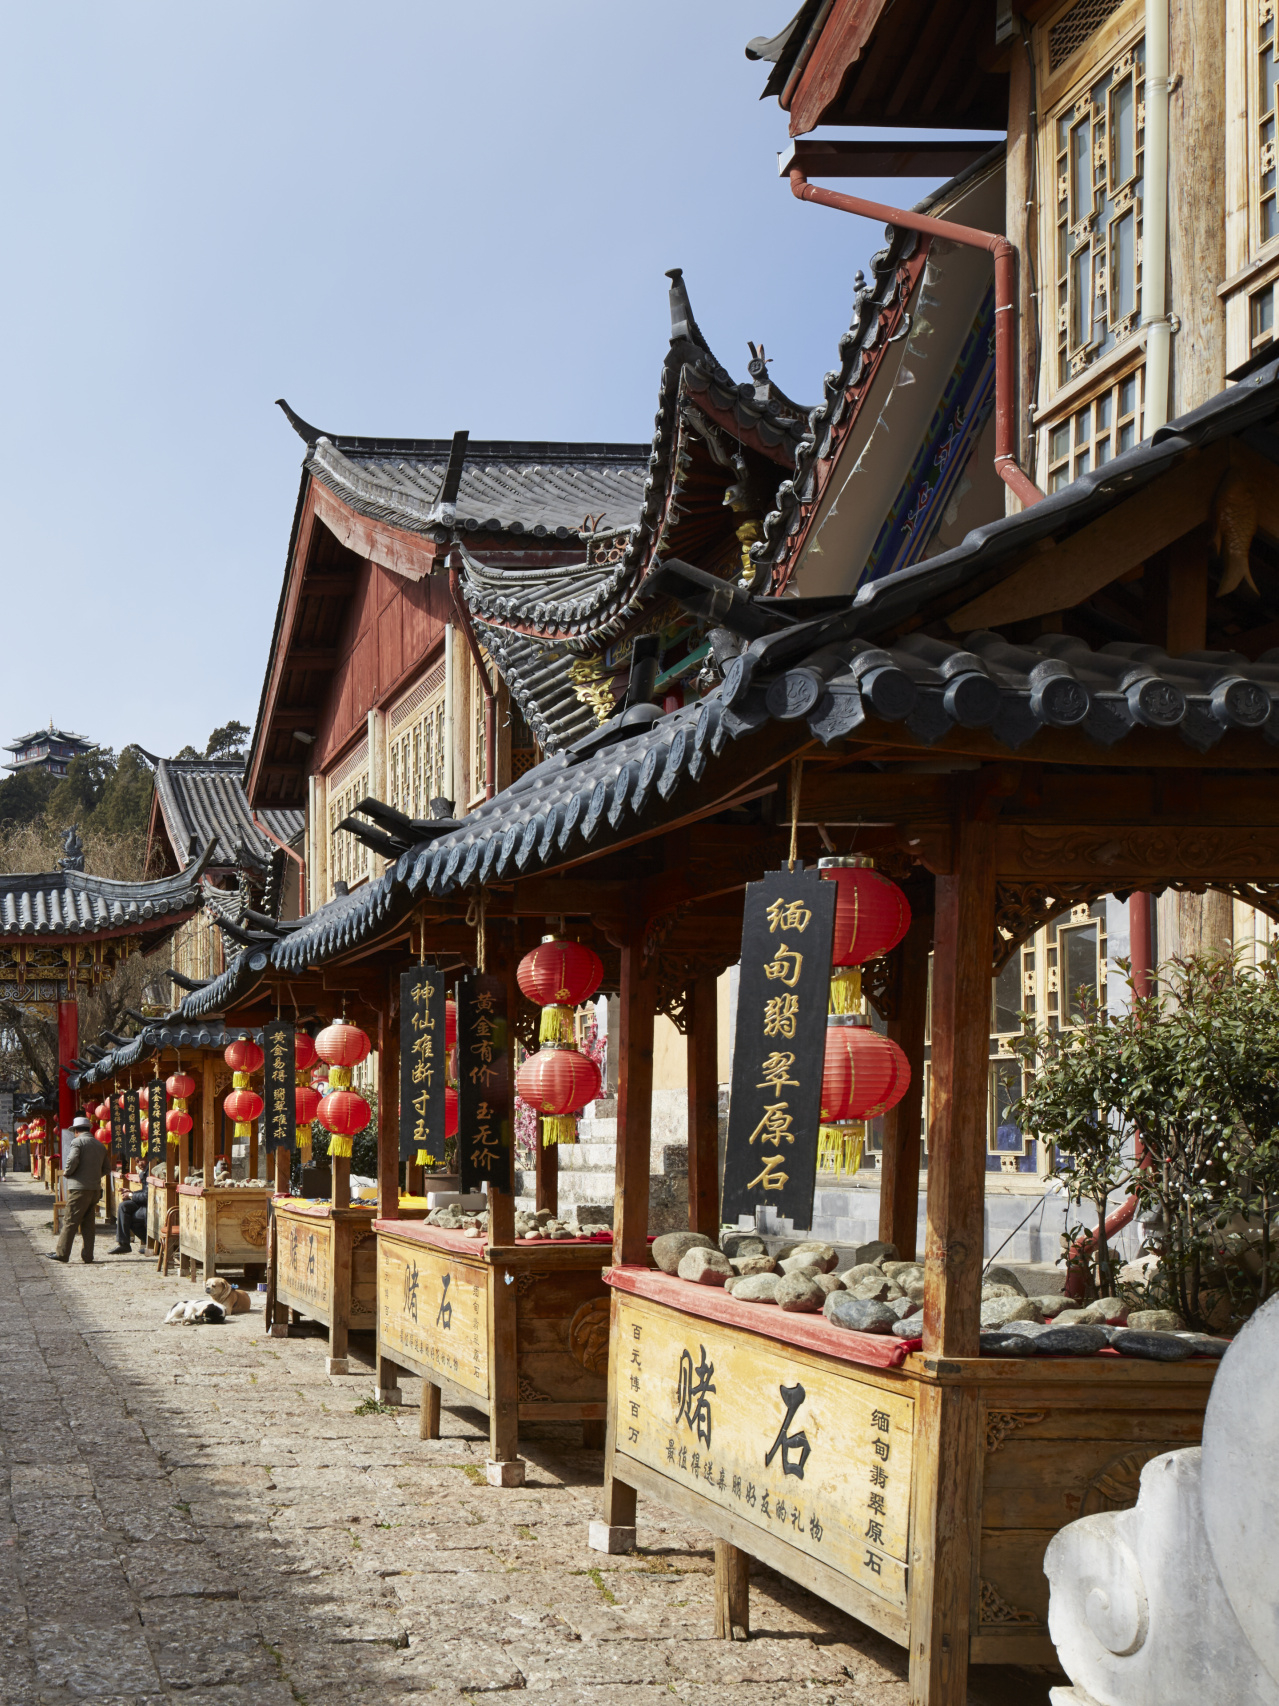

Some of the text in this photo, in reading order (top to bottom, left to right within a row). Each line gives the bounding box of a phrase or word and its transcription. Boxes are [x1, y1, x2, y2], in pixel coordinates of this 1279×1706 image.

[269, 1030, 288, 1139] 黄金易得 翡翠难求
[410, 980, 435, 1142] 神仙难断寸玉
[469, 991, 500, 1172] 黄金有价 玉无价
[747, 897, 812, 1191] 缅甸翡翠原石
[403, 1258, 453, 1331] 赌石
[628, 1323, 643, 1445] 百元博百万
[675, 1343, 812, 1482] 赌石
[666, 1438, 824, 1543] 最值得送亲朋好友的礼物
[863, 1408, 891, 1577] 缅甸翡翠原石
